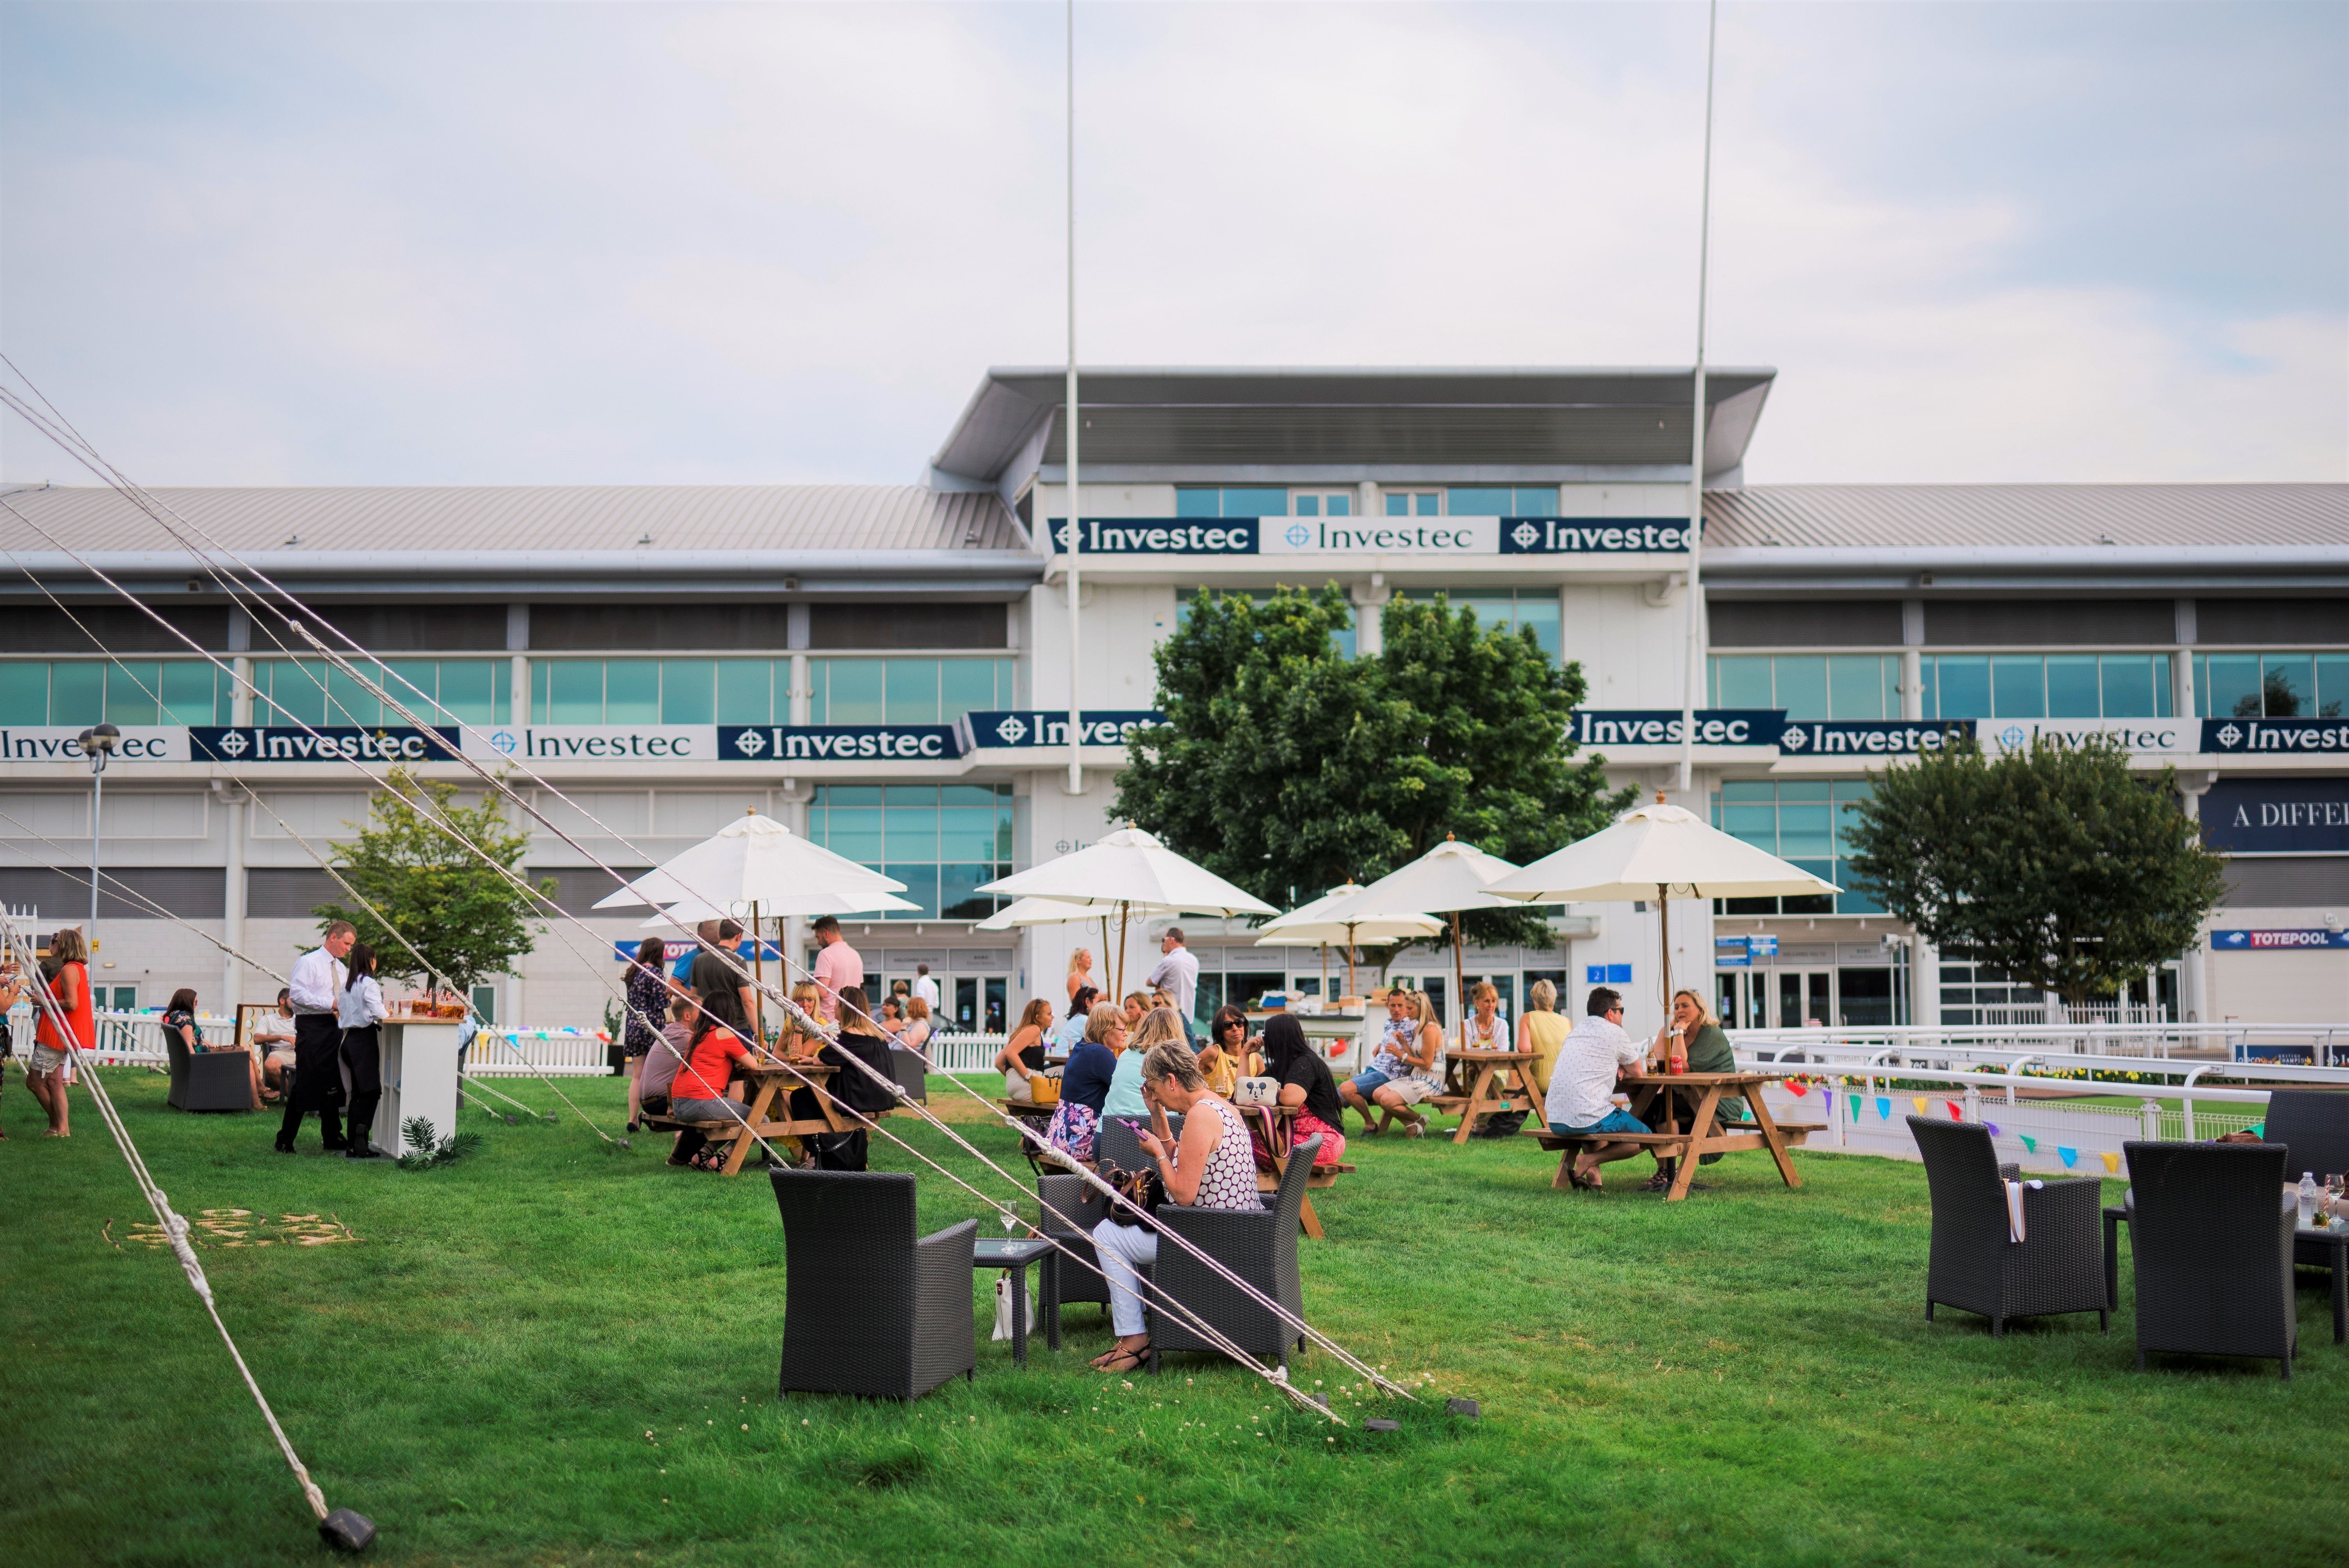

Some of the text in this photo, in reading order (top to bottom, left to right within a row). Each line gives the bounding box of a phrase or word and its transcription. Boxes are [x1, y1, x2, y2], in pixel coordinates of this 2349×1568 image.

[1089, 522, 1249, 549] Investec
[1318, 522, 1472, 548] Investec
[1581, 713, 1749, 743] Investec
[1, 730, 166, 757] Inveec
[254, 729, 424, 758] Investec
[526, 729, 691, 756] Investec
[772, 728, 943, 758] Investec
[2231, 803, 2252, 827] A
[2253, 931, 2329, 946] TOTEPOOL
[1594, 971, 1600, 980] 2
